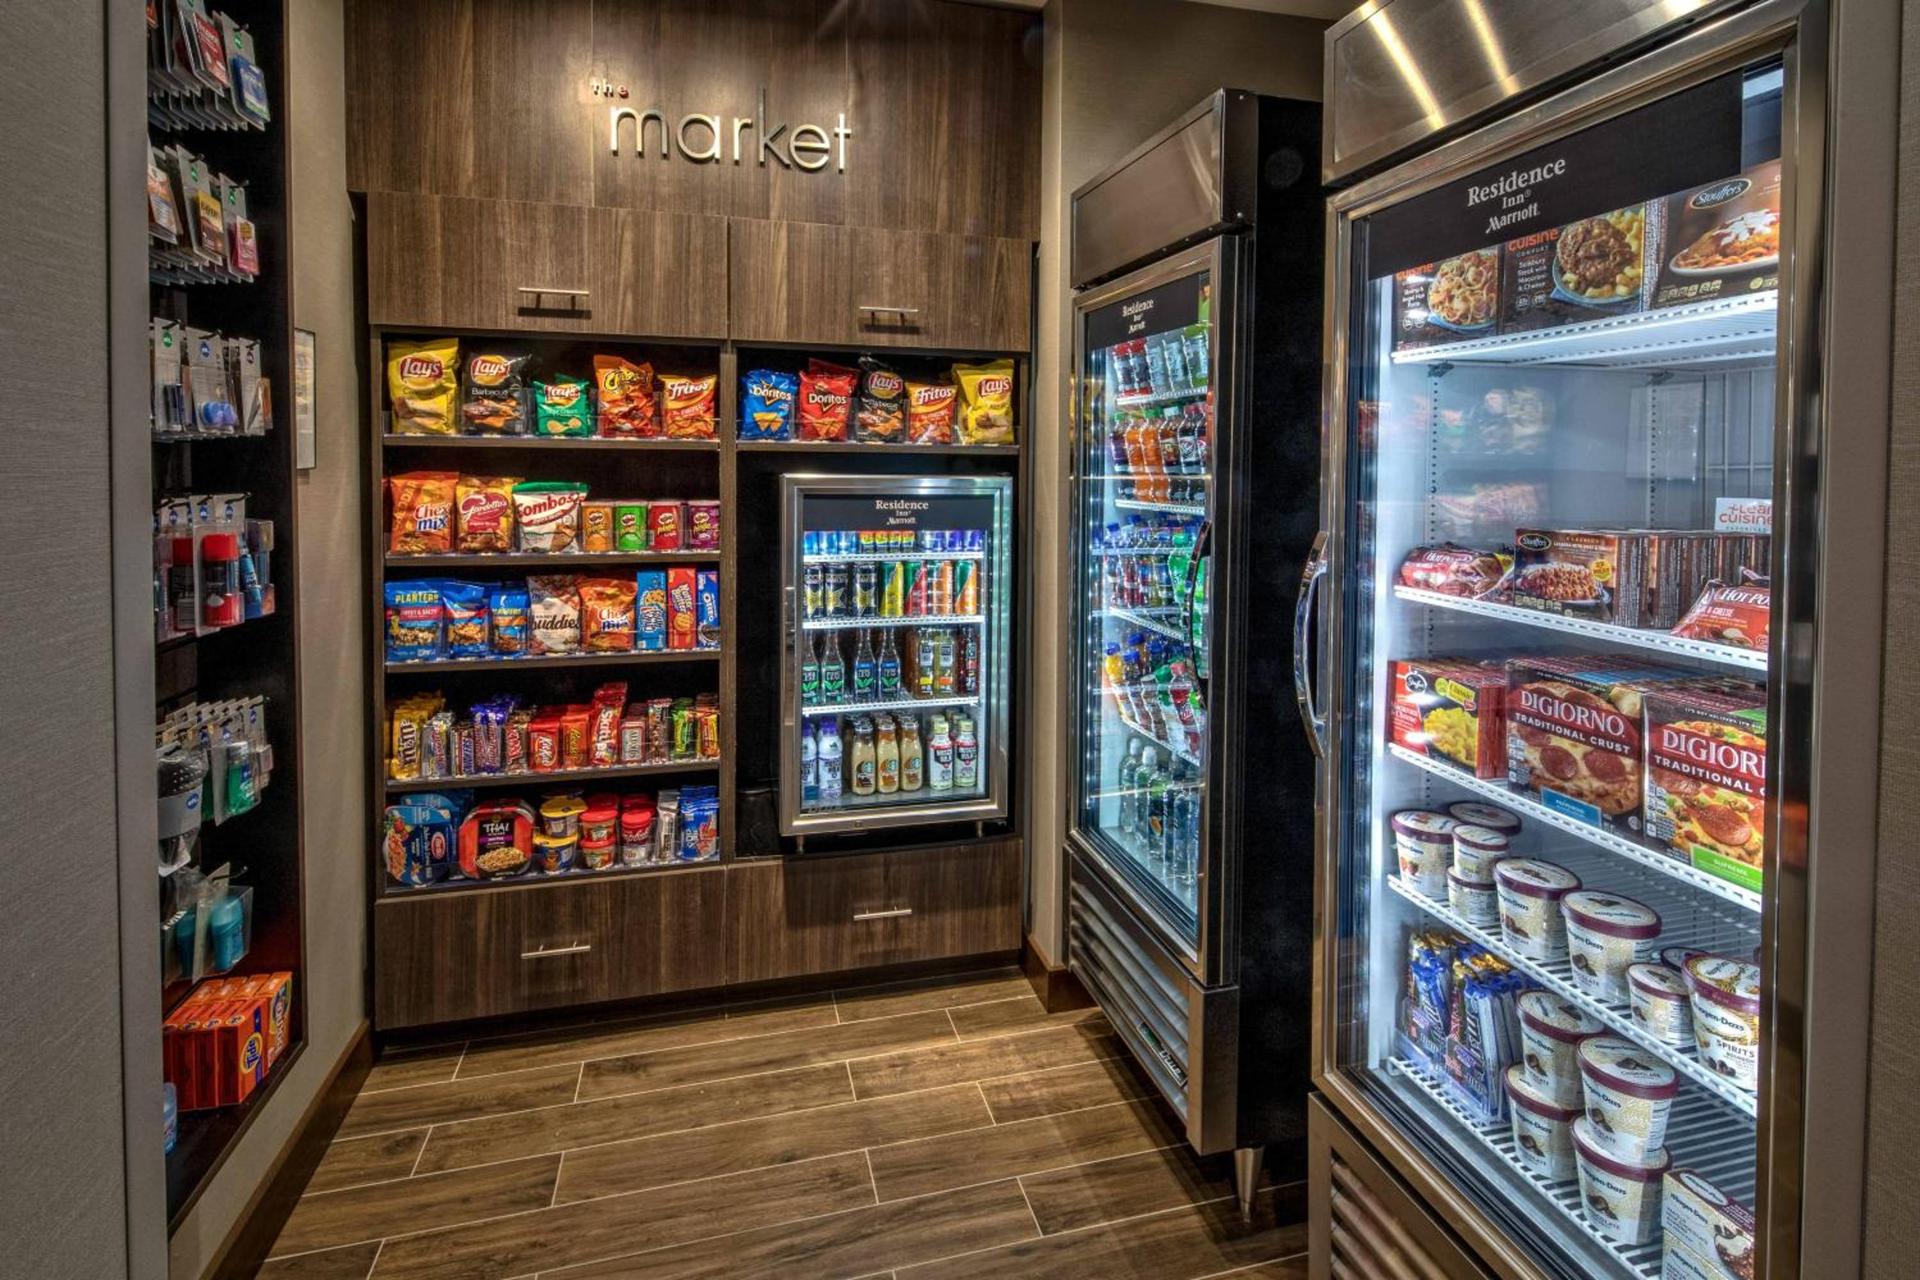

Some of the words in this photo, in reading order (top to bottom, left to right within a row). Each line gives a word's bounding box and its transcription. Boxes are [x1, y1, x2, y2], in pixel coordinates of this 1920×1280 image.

[609, 85, 853, 174] market
[1467, 157, 1567, 207] Residence
[1698, 181, 1744, 203] Stouffer's
[1485, 202, 1539, 234] Marriott
[1121, 299, 1156, 318] Residence
[668, 379, 710, 399] Fritos
[752, 386, 792, 401] Doritos
[808, 393, 848, 405] Doritos
[915, 387, 952, 404] Fritos
[516, 492, 578, 517] Combos
[875, 499, 929, 510] Residence
[1720, 588, 1751, 603] HOT
[1520, 689, 1625, 738] DIGIORNO
[1514, 712, 1586, 742] TRADITIONAL
[1589, 736, 1631, 755] CRUST
[1654, 754, 1754, 793] TRADITIONAL
[481, 822, 510, 833] THAI
[246, 1038, 260, 1070] Tide
[1716, 1039, 1756, 1058] SPIRITS
